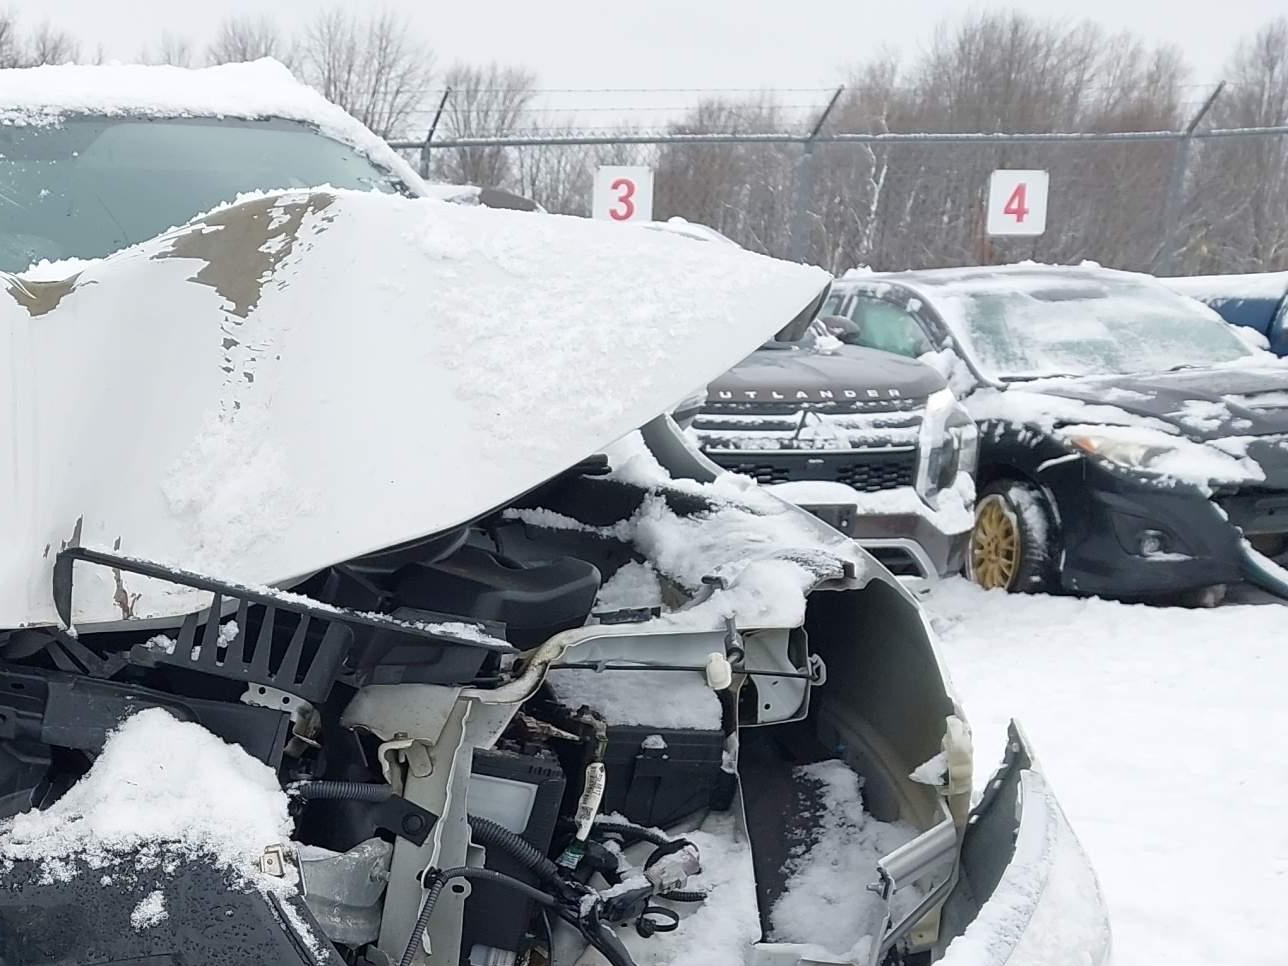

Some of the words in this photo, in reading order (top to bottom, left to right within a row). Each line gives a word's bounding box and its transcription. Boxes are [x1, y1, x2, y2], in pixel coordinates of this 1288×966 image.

[609, 178, 635, 221] 3
[1002, 184, 1030, 223] 4
[719, 389, 901, 399] UTLANDER
